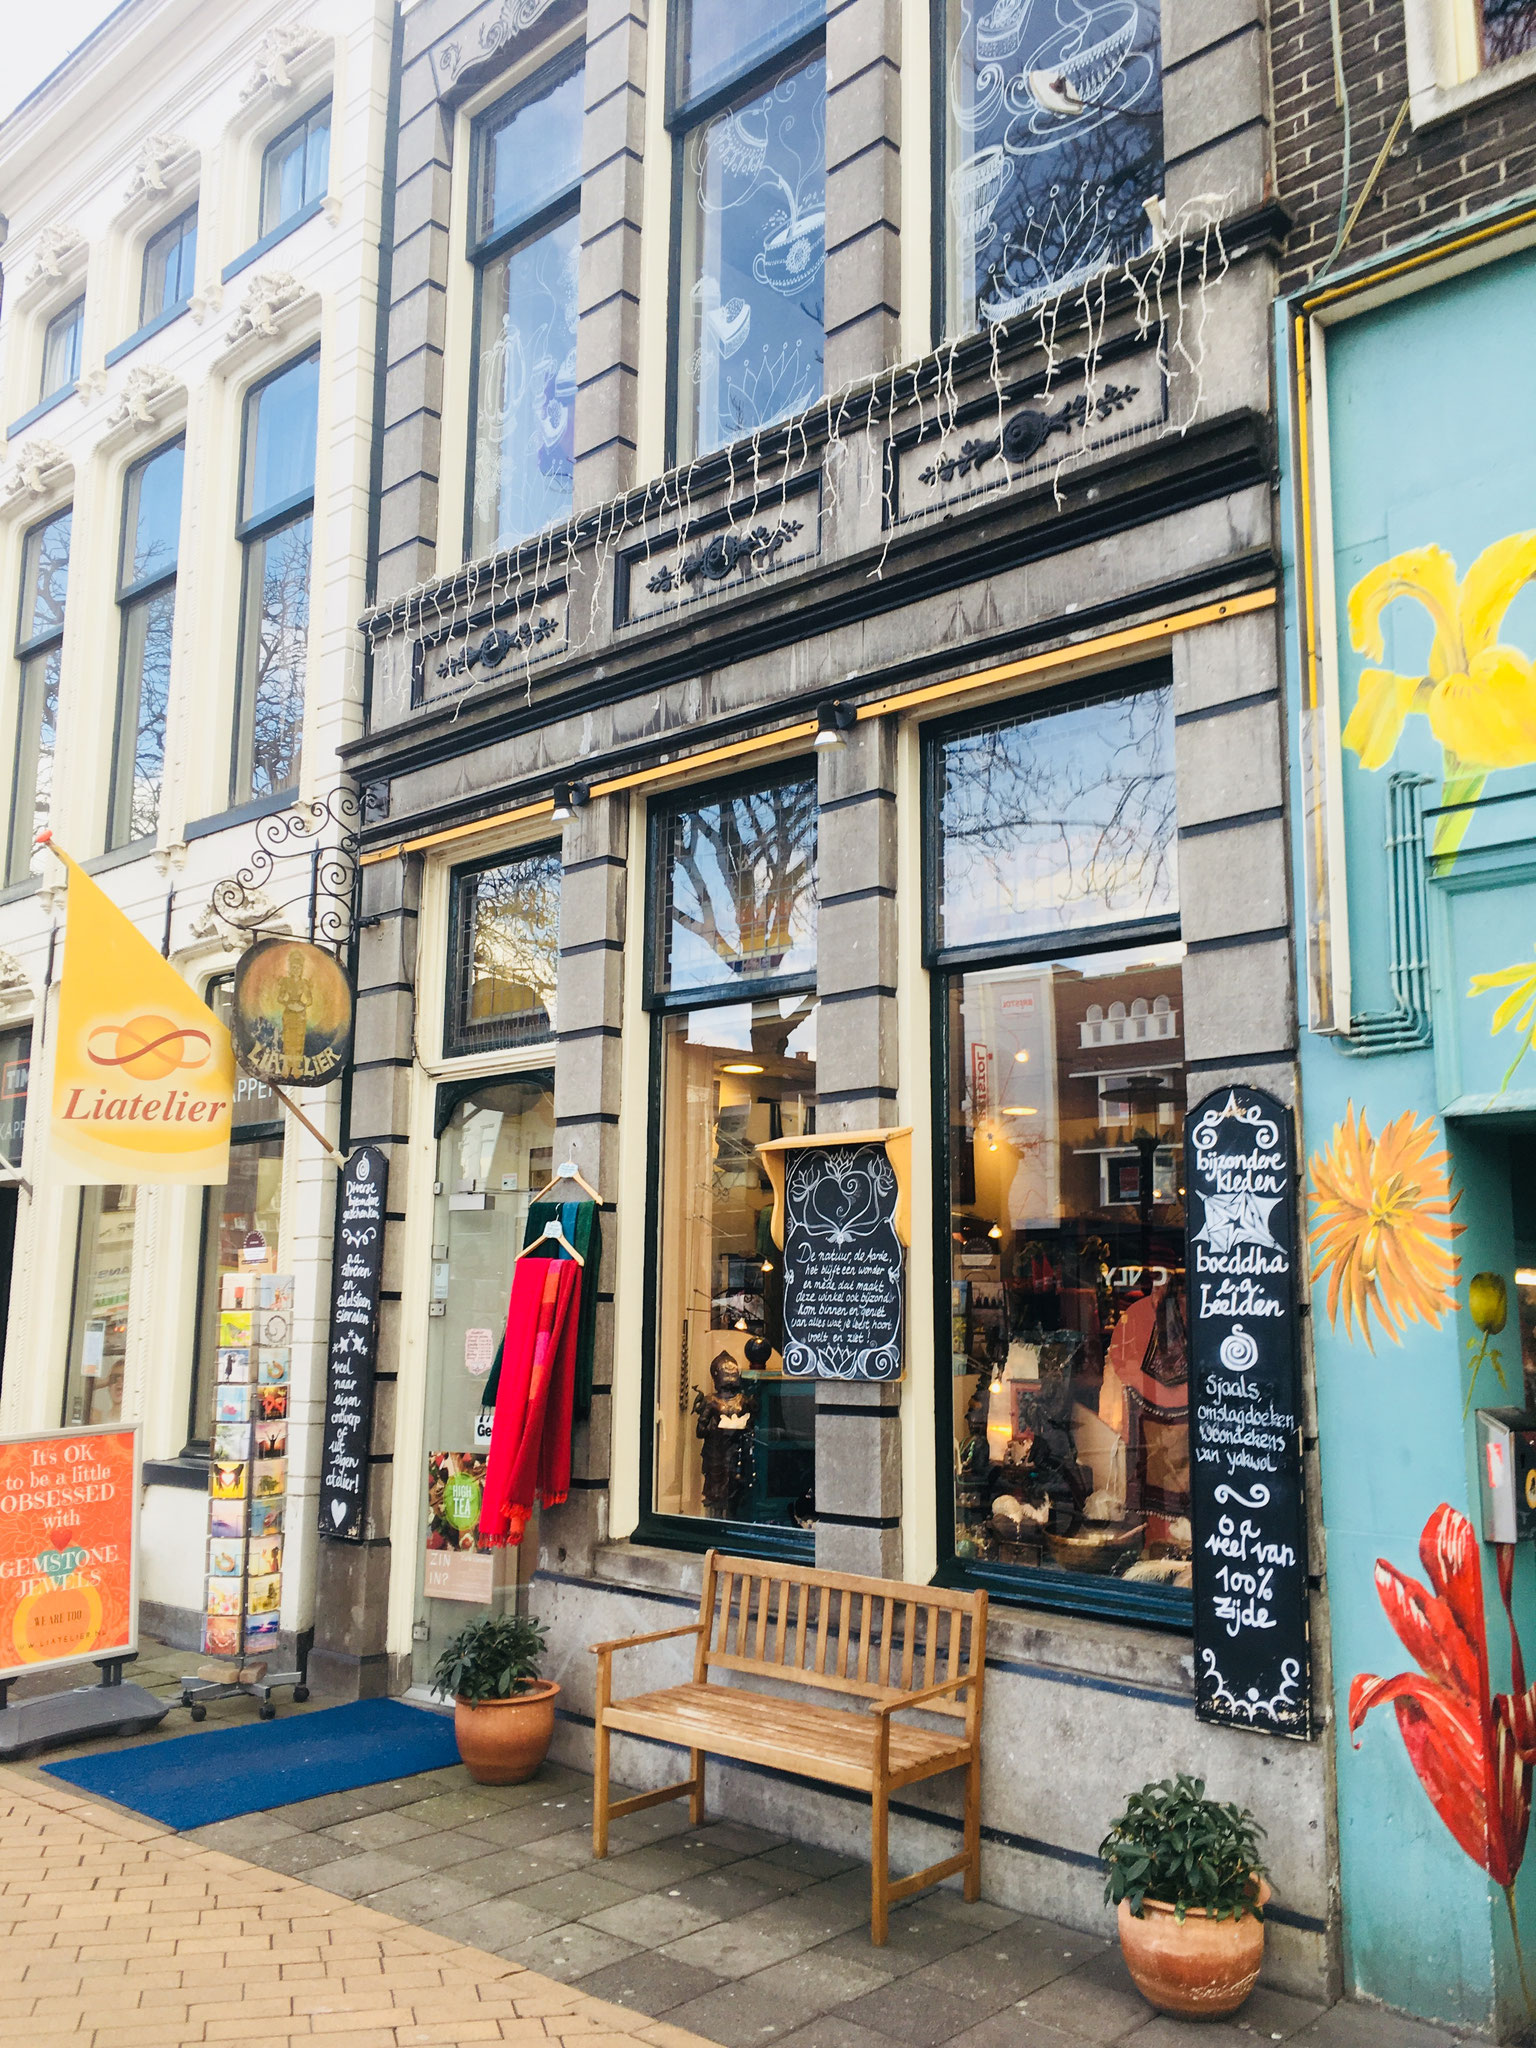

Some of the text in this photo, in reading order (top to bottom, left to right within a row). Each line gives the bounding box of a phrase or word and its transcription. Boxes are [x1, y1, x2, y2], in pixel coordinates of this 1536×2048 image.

[62, 1088, 227, 1122] Liatelier
[1196, 1148, 1286, 1182] bijzondere
[346, 1180, 377, 1197] Diverse
[1216, 1169, 1288, 1194] kleden
[796, 1242, 817, 1264] De
[853, 1247, 866, 1261] de
[1196, 1245, 1290, 1275] boeddha
[805, 1263, 885, 1282] het blijft een wonder
[341, 1279, 357, 1291] en
[802, 1280, 885, 1293] en mede dat maakt
[795, 1290, 817, 1303] deze
[817, 1291, 845, 1303] winkel
[845, 1292, 860, 1303] ook
[1199, 1283, 1286, 1319] beelden
[818, 1303, 849, 1316] binnen
[848, 1305, 861, 1317] en
[791, 1318, 808, 1328] van
[808, 1317, 827, 1328] alles
[826, 1318, 843, 1328] wat
[871, 1319, 893, 1331] hoort
[807, 1330, 829, 1343] voelt
[832, 1332, 844, 1342] en
[332, 1356, 354, 1376] veel
[334, 1379, 358, 1391] naar
[333, 1392, 362, 1414] eigen
[337, 1425, 348, 1440] of
[64, 1444, 95, 1464] OK
[1196, 1447, 1221, 1464] van
[329, 1454, 360, 1476] eigen
[6, 1463, 111, 1491] to be a little
[325, 1467, 360, 1494] atelier!
[0, 1482, 115, 1514] OBSESSED
[452, 1484, 473, 1498] HIGH
[453, 1500, 472, 1516] TEA
[42, 1508, 81, 1529] with
[429, 1552, 451, 1567] ZIN
[1204, 1533, 1296, 1567] veel van
[0, 1544, 119, 1579] GEMSTONE
[15, 1569, 102, 1599] JEWELS
[429, 1572, 449, 1586] IN?
[1215, 1564, 1274, 1601] 100%
[33, 1609, 82, 1627] WE ARE TOO
